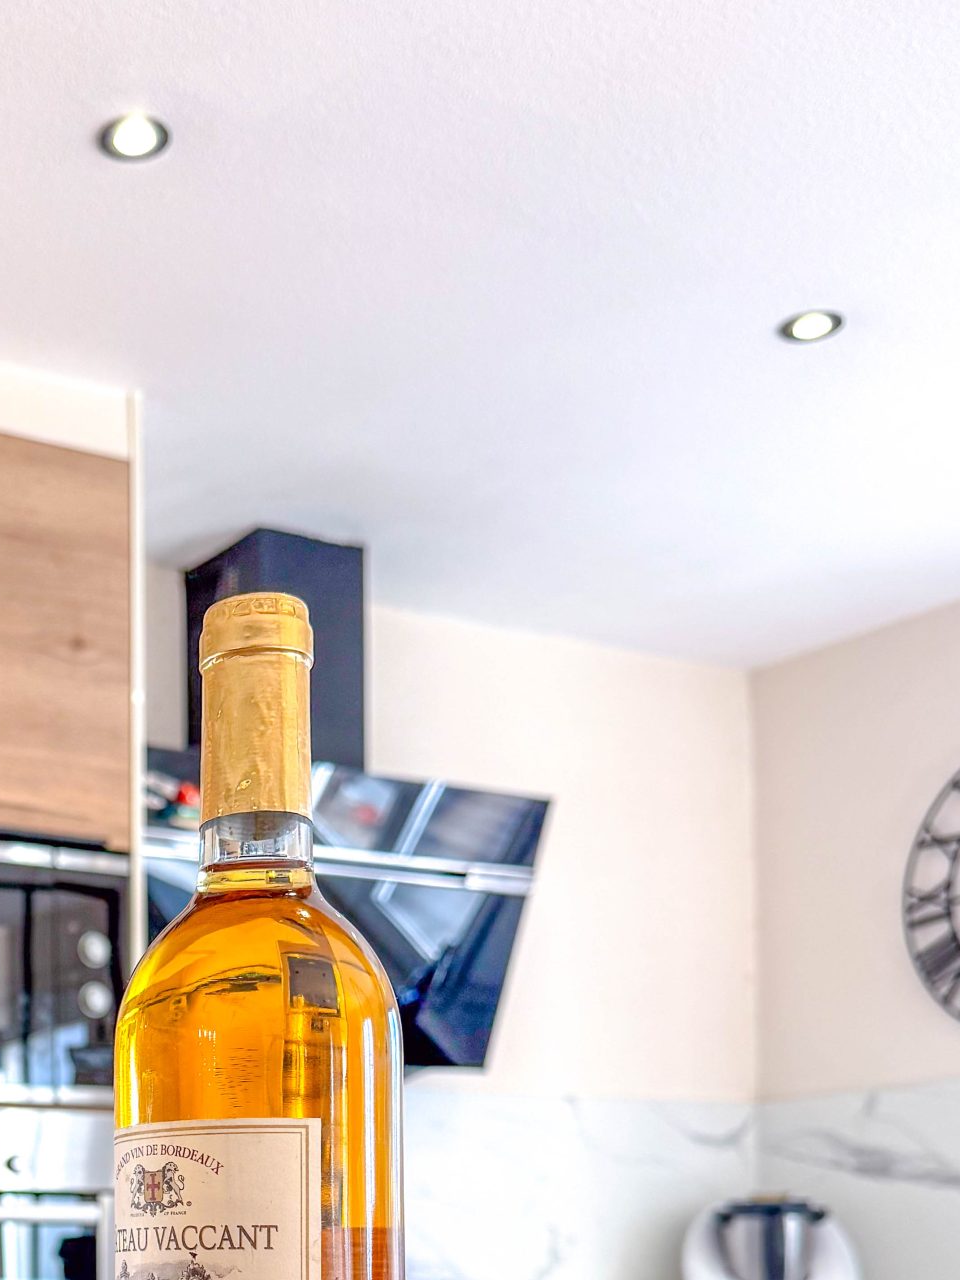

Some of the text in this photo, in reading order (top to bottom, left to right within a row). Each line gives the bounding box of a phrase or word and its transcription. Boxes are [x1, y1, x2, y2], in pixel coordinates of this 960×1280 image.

[130, 1145, 144, 1159] VIN
[146, 1144, 158, 1156] DE
[160, 1144, 225, 1175] BORDEAUX
[153, 1225, 279, 1250] VACCANT
